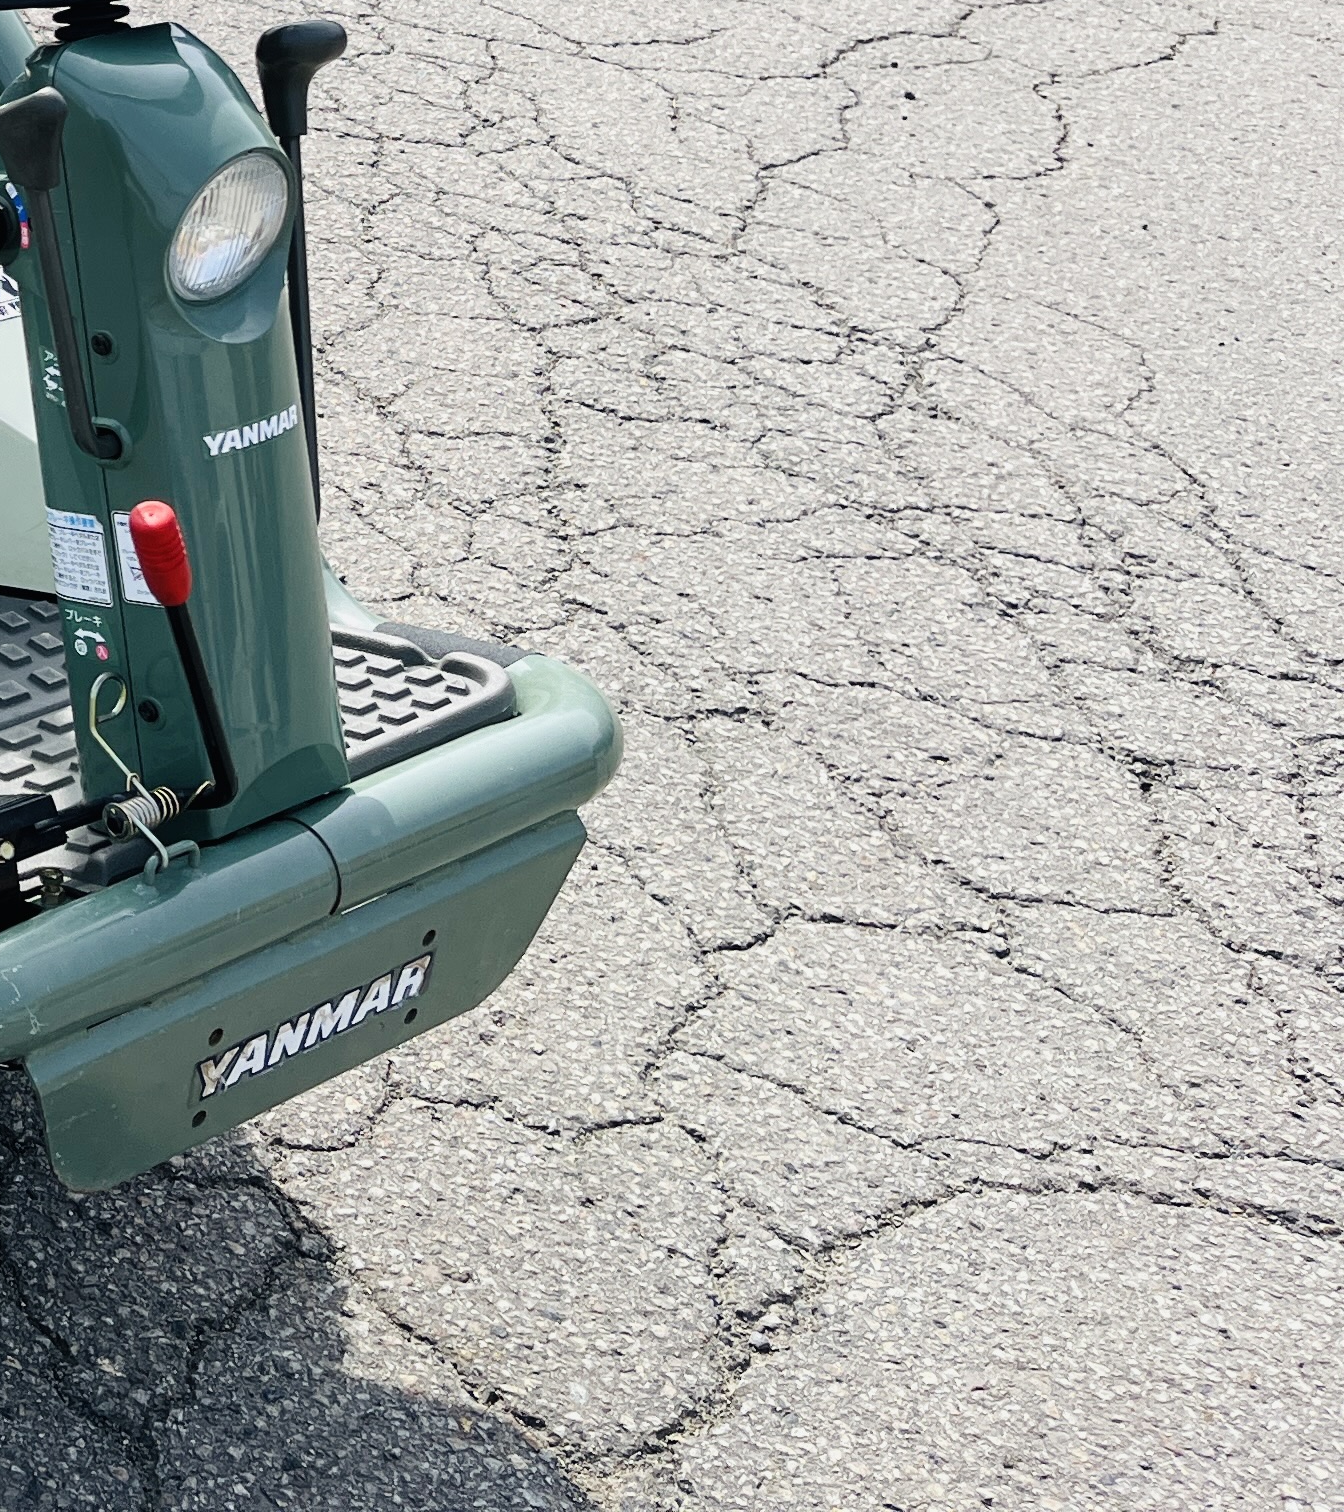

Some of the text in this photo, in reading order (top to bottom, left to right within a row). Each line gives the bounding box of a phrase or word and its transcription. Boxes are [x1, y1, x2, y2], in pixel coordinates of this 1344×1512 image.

[203, 404, 298, 457] YANMAR
[64, 608, 103, 628] ブレーキ
[199, 954, 432, 1098] YANMAR
